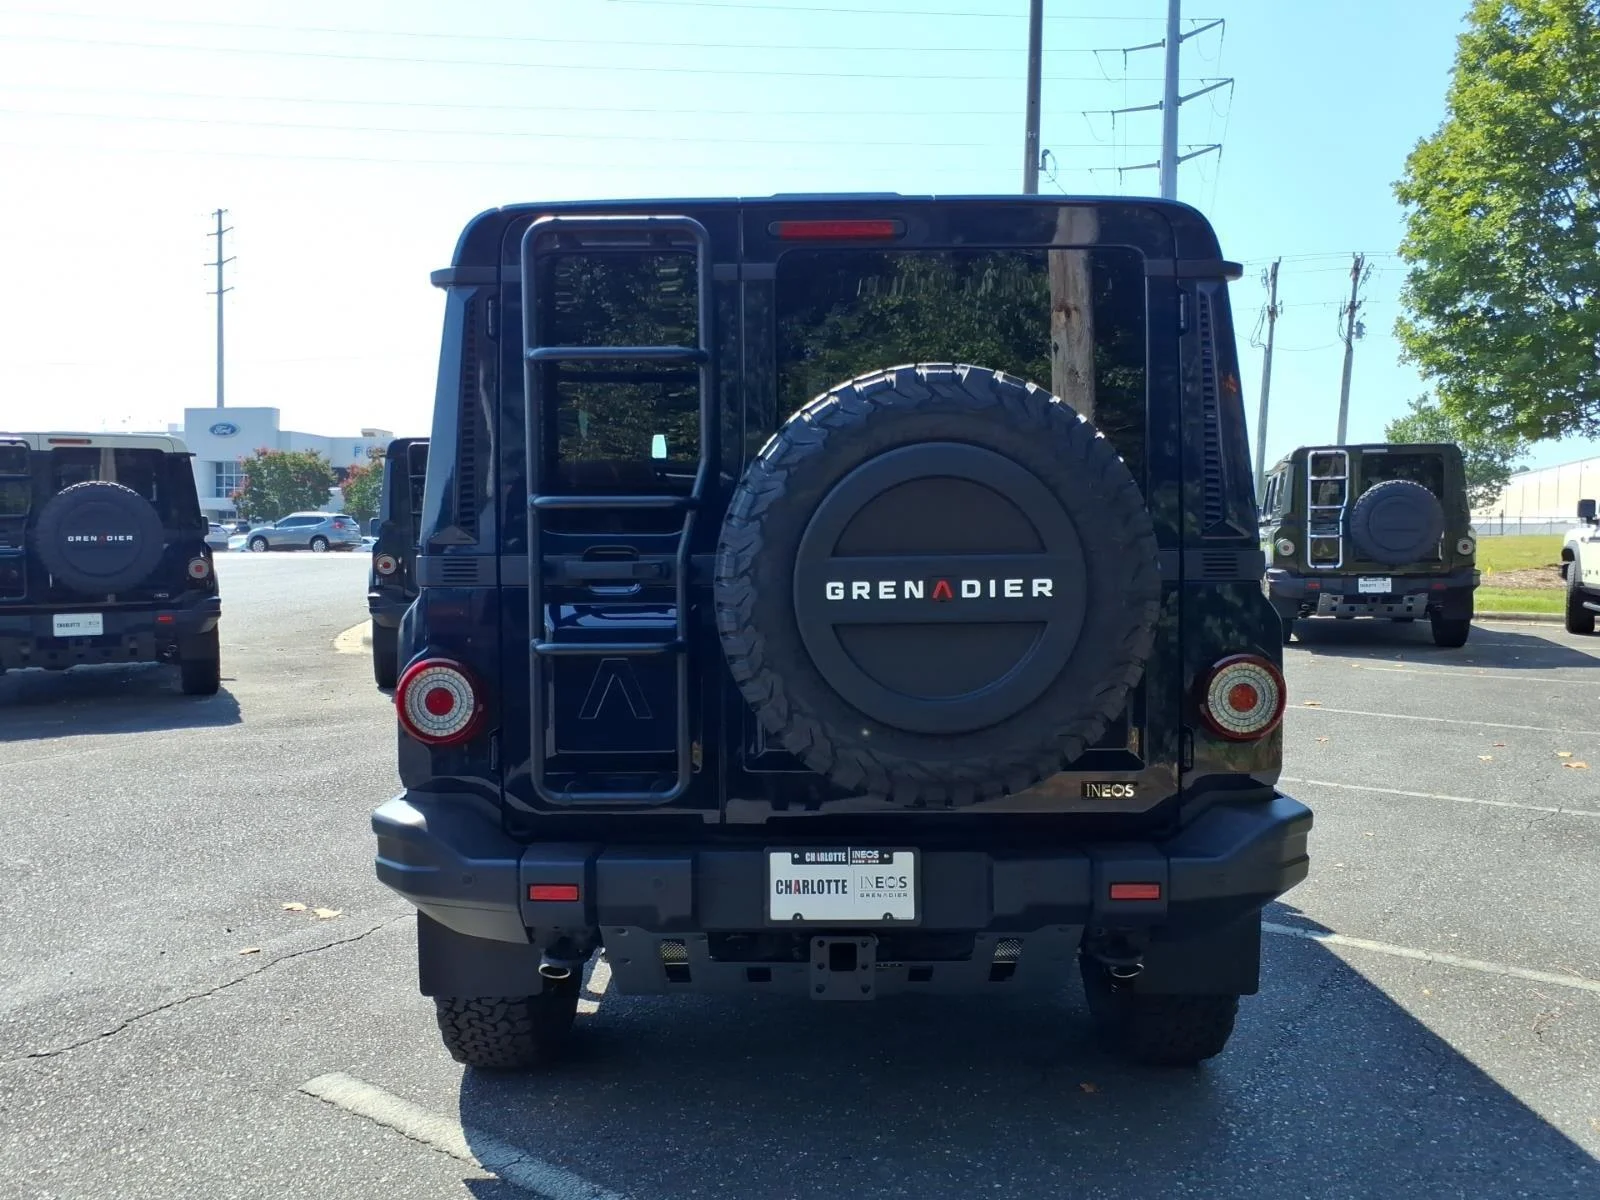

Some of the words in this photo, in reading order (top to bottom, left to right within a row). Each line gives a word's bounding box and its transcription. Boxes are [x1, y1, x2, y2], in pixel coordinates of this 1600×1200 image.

[826, 579, 1053, 600] GRENADIER
[1086, 783, 1135, 798] INEOS
[805, 852, 846, 862] CHARLOTTE
[852, 850, 880, 859] INEOS
[776, 879, 848, 895] CHARLOTTE
[860, 876, 908, 889] INEOS
